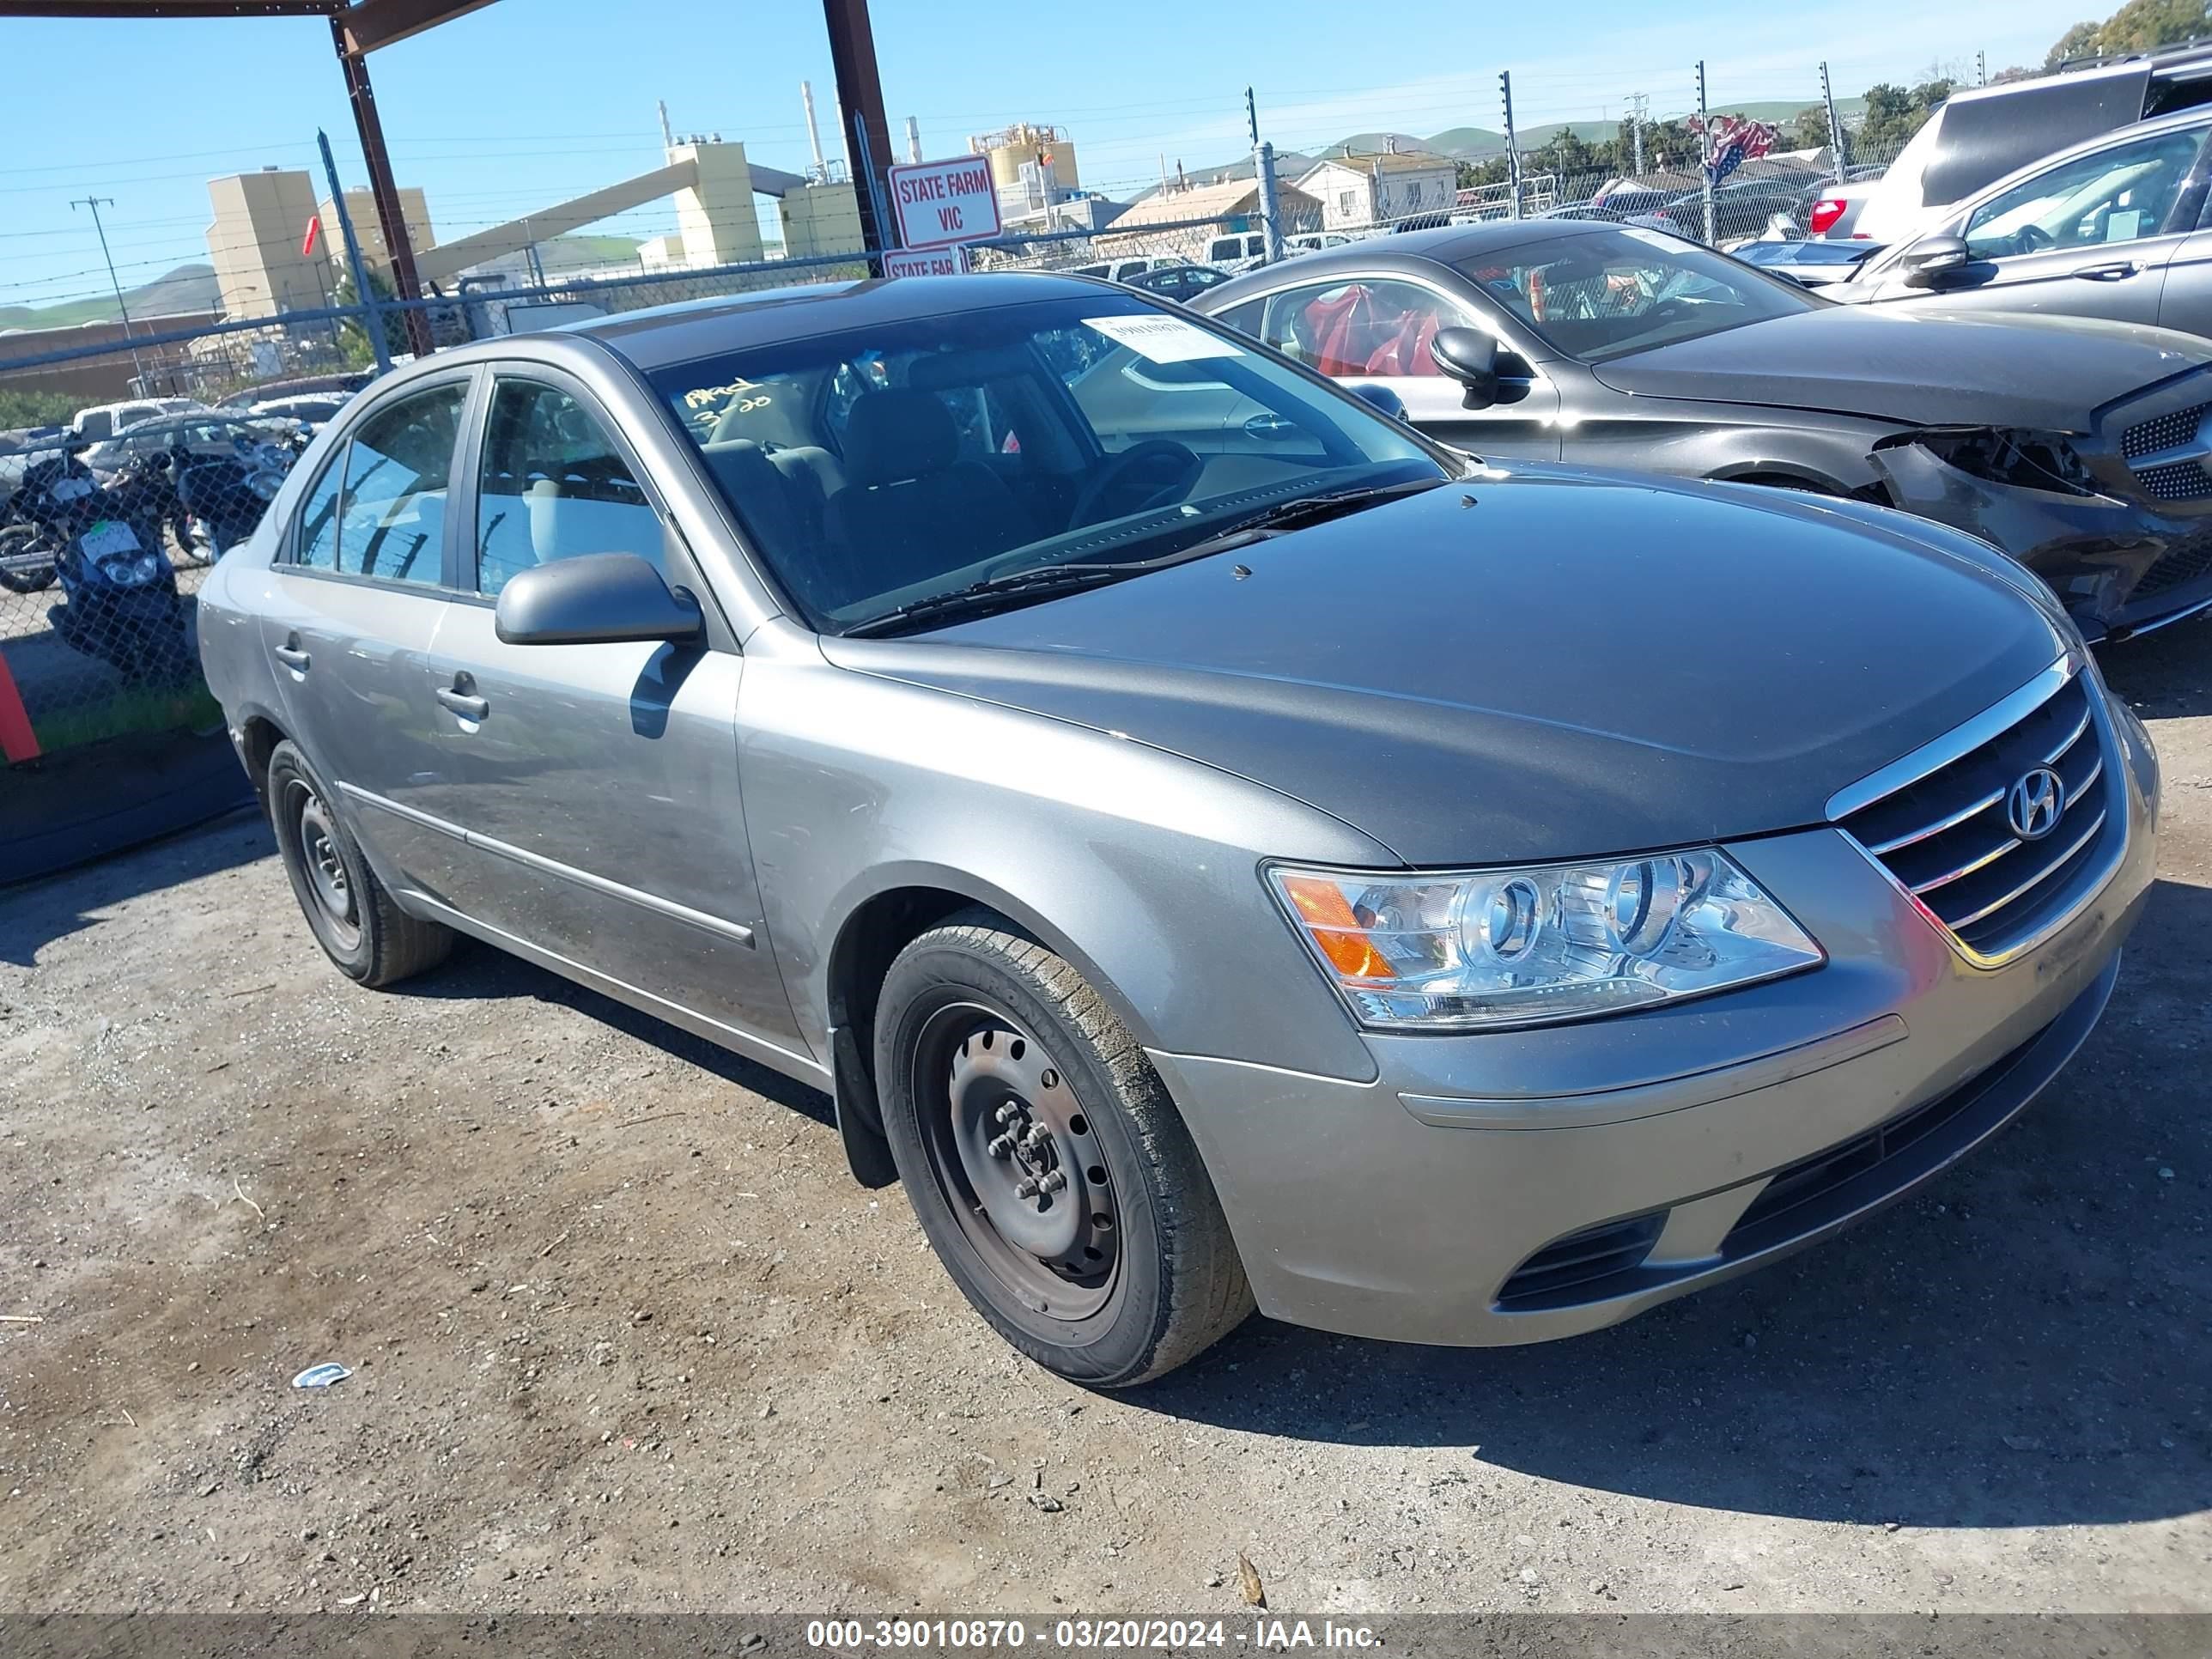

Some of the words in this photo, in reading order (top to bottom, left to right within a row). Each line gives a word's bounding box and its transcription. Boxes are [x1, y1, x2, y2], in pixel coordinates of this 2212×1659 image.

[899, 175, 945, 204] STATE
[946, 169, 988, 198] FARM
[938, 205, 963, 232] VIC
[931, 258, 957, 276] FAR
